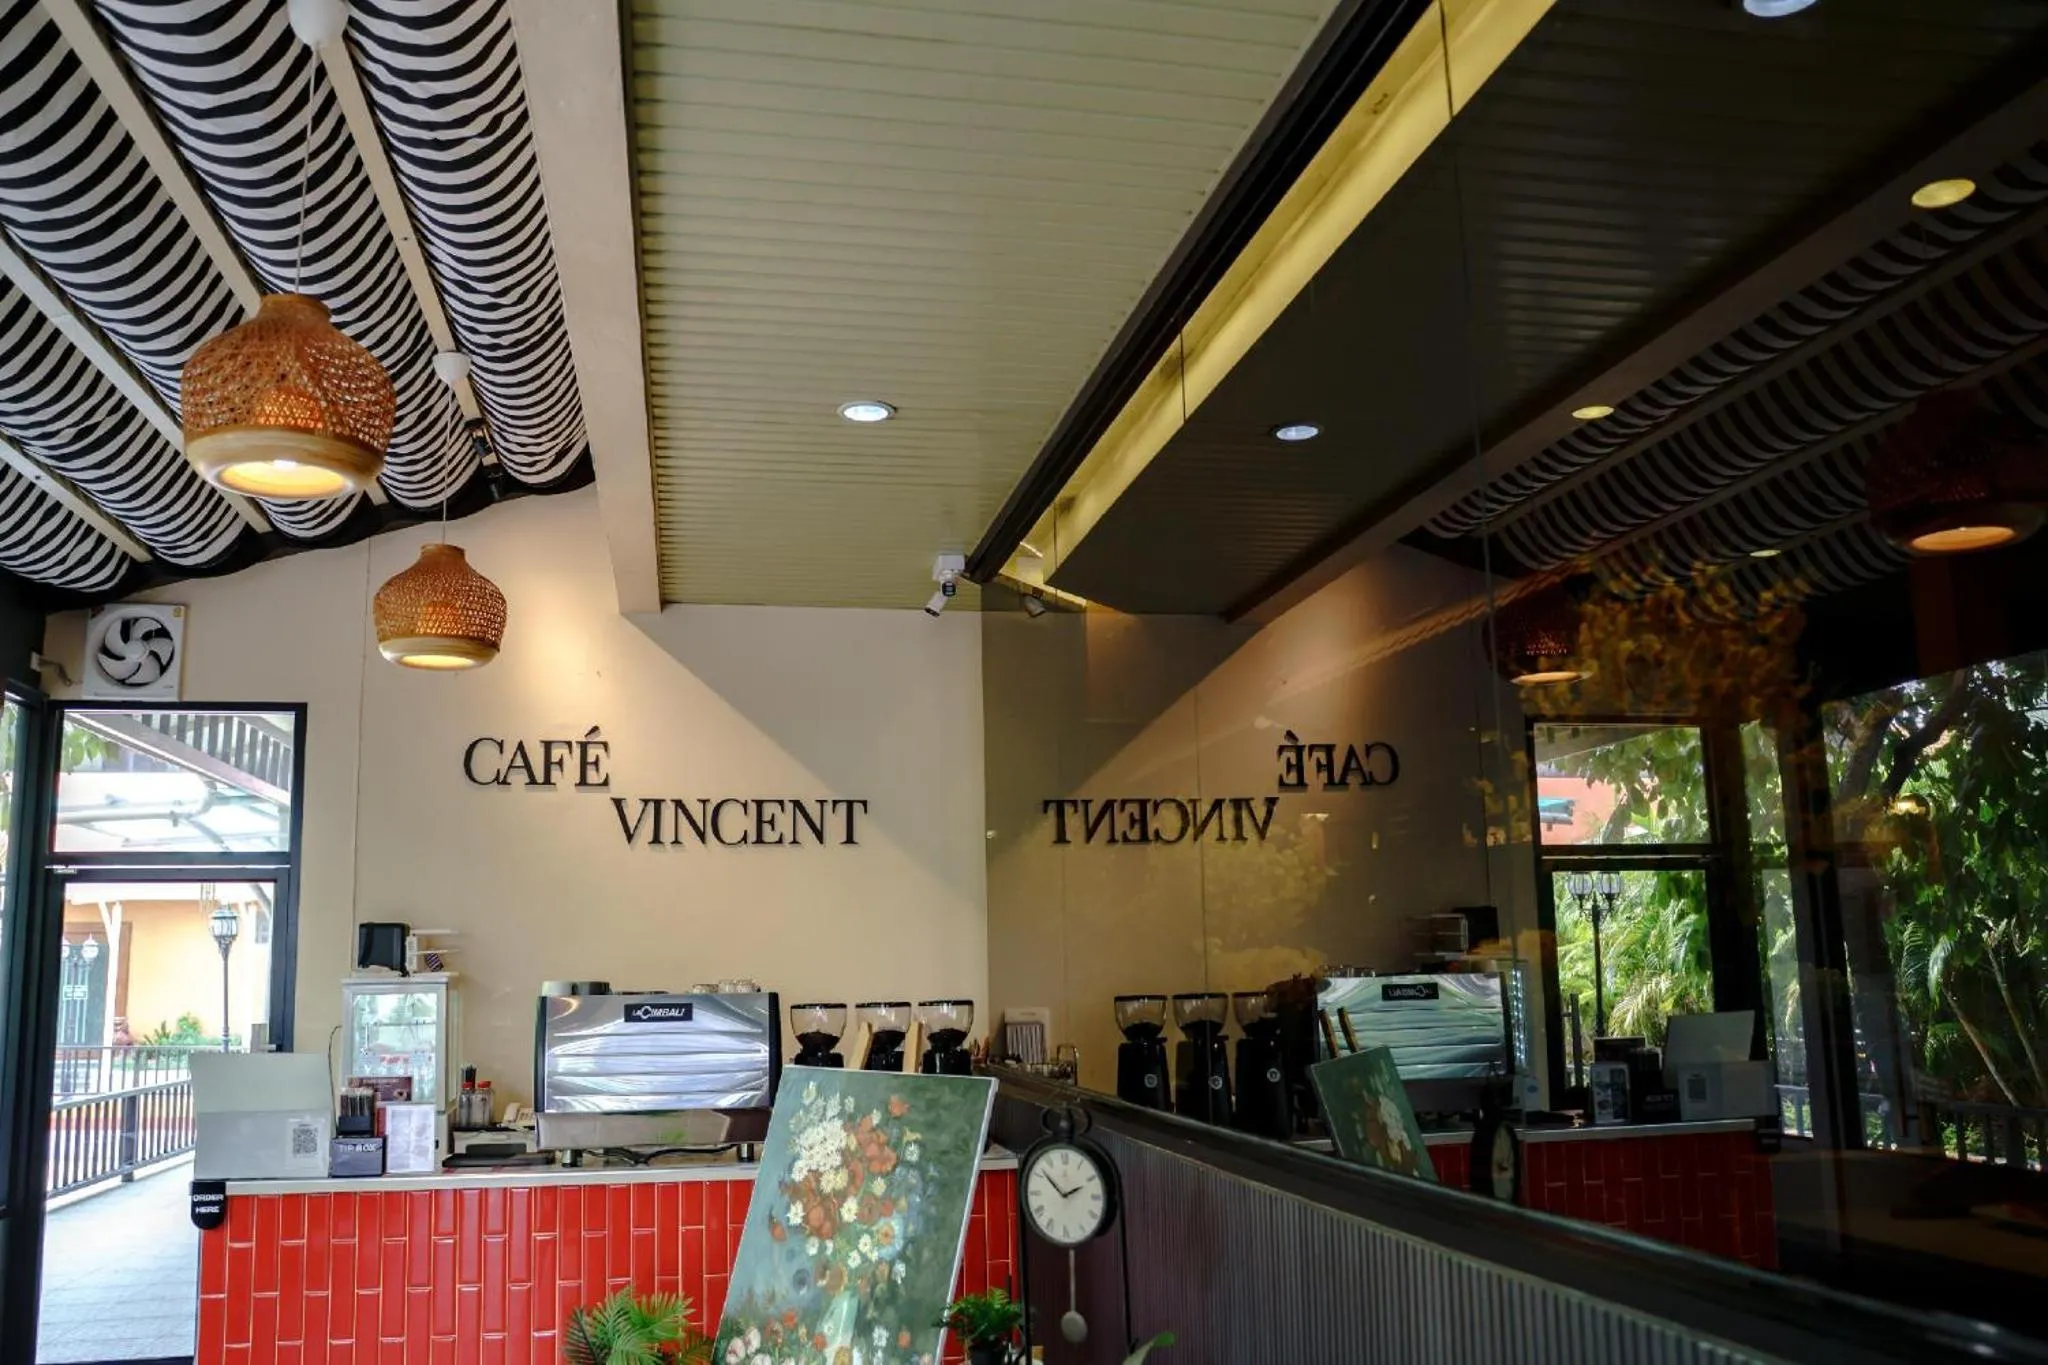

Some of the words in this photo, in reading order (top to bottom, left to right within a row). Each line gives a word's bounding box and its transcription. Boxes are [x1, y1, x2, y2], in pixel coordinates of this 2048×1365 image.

[463, 725, 610, 788] CAFÉ
[609, 797, 868, 846] VINCENT
[641, 1005, 686, 1019] CIMBALI
[193, 1194, 224, 1202] ORDER
